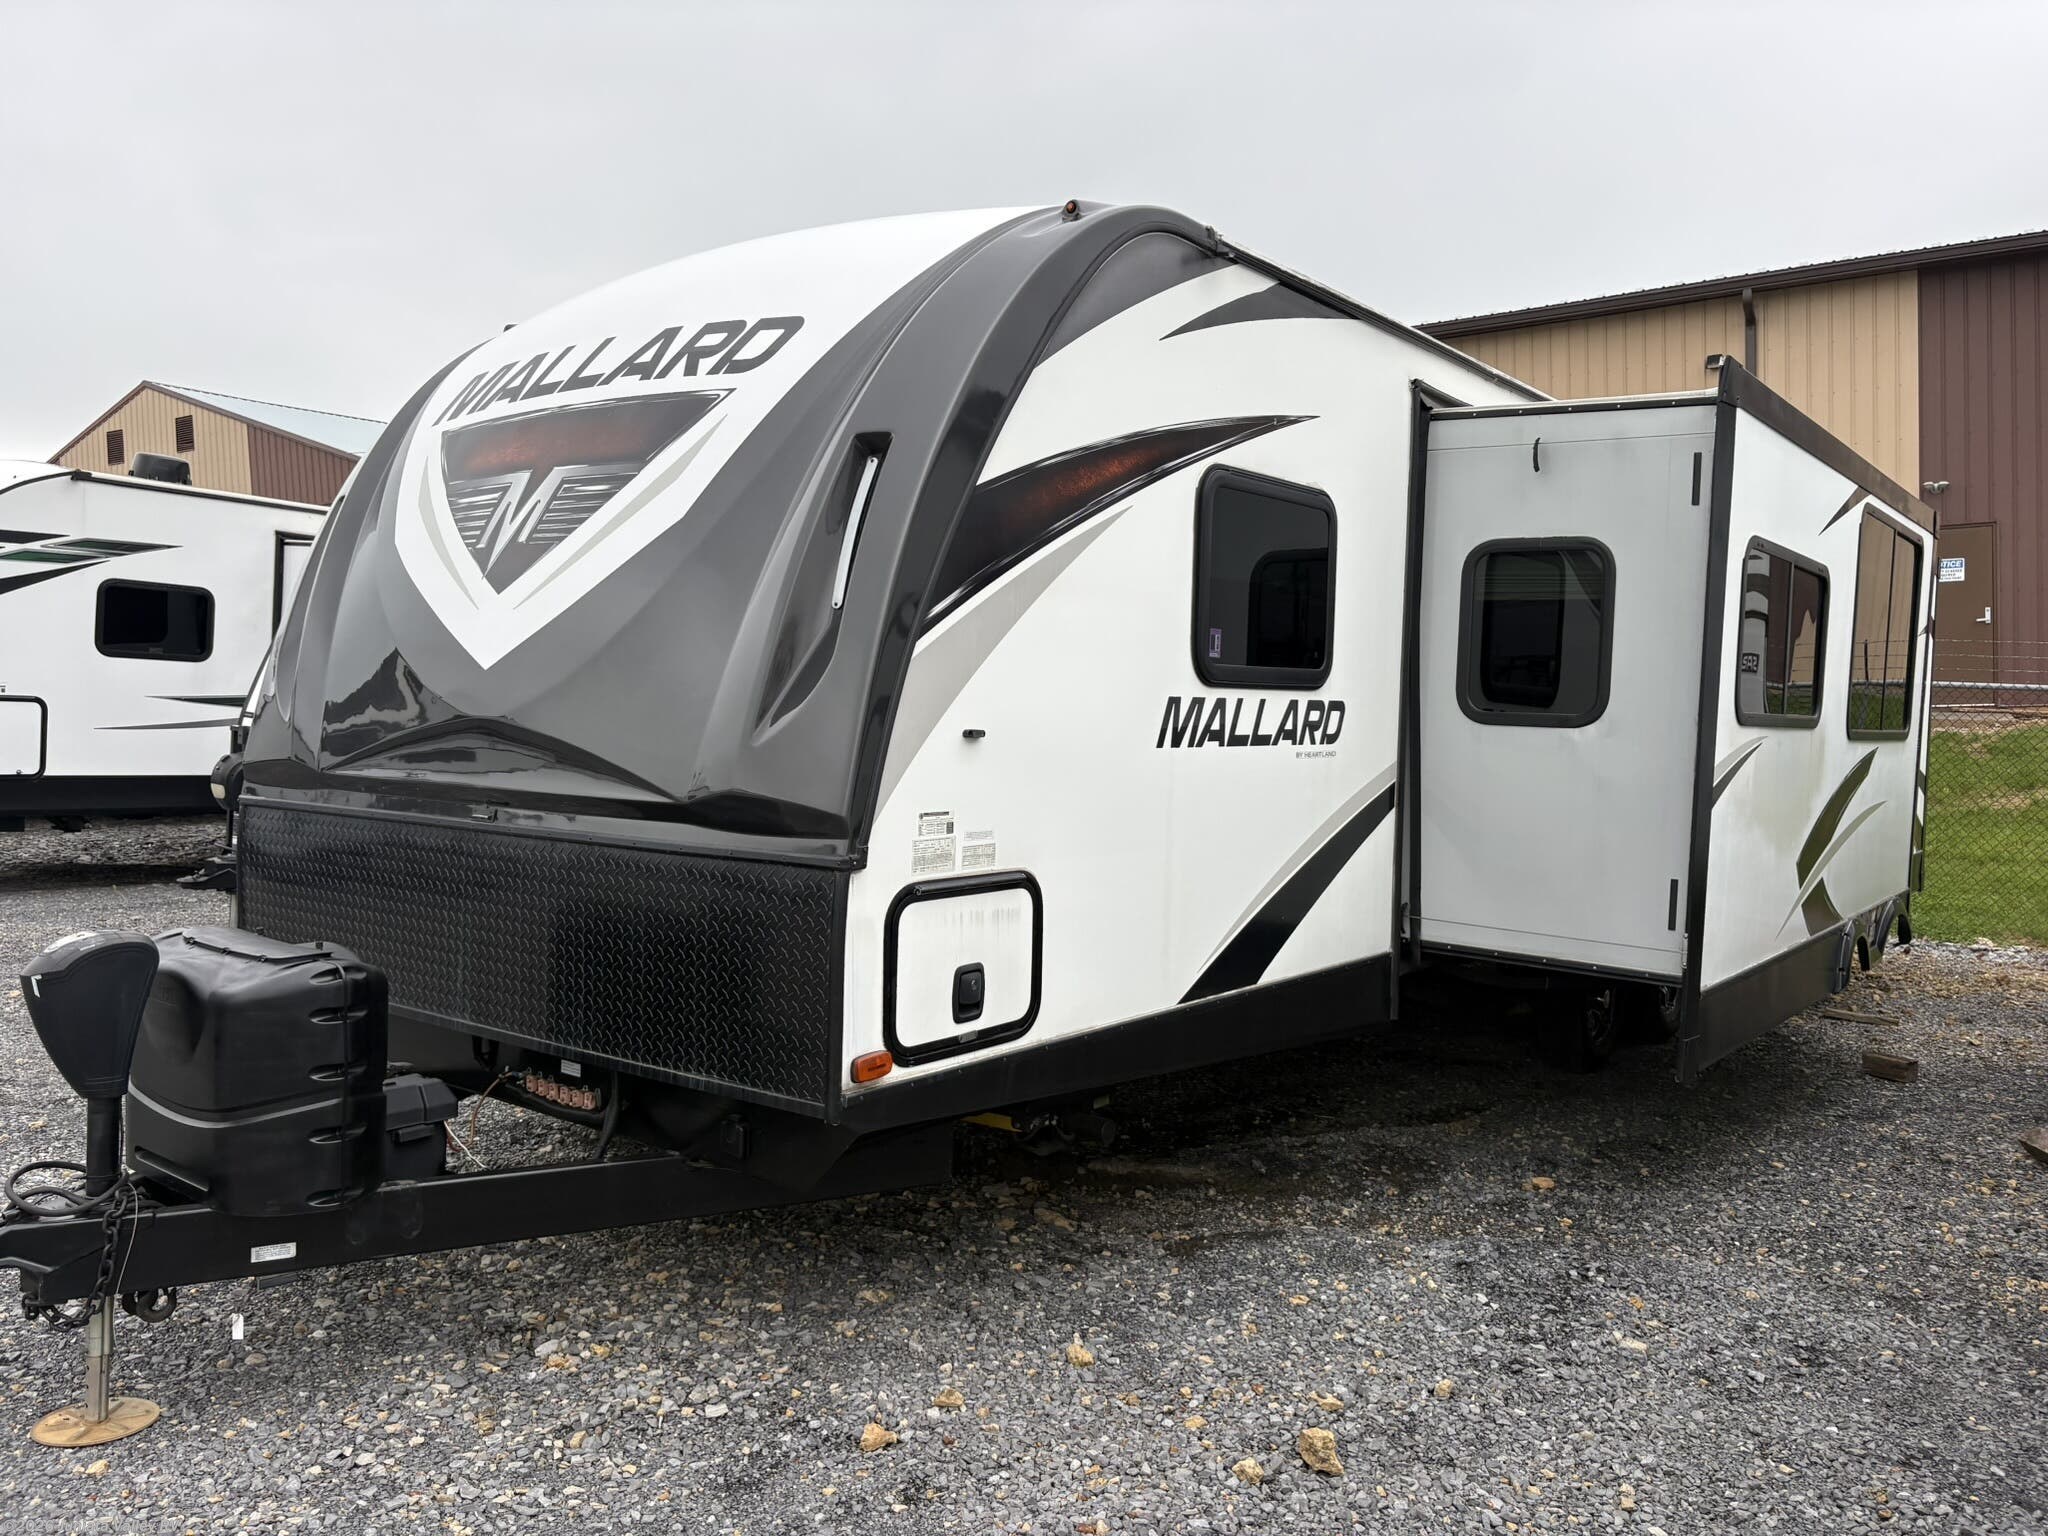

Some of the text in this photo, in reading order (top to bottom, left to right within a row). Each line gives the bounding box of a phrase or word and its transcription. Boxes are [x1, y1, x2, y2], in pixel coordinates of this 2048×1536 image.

[432, 316, 804, 427] MALLARD
[1156, 696, 1345, 748] MALLARD
[1304, 750, 1337, 759] HEARTLAND
